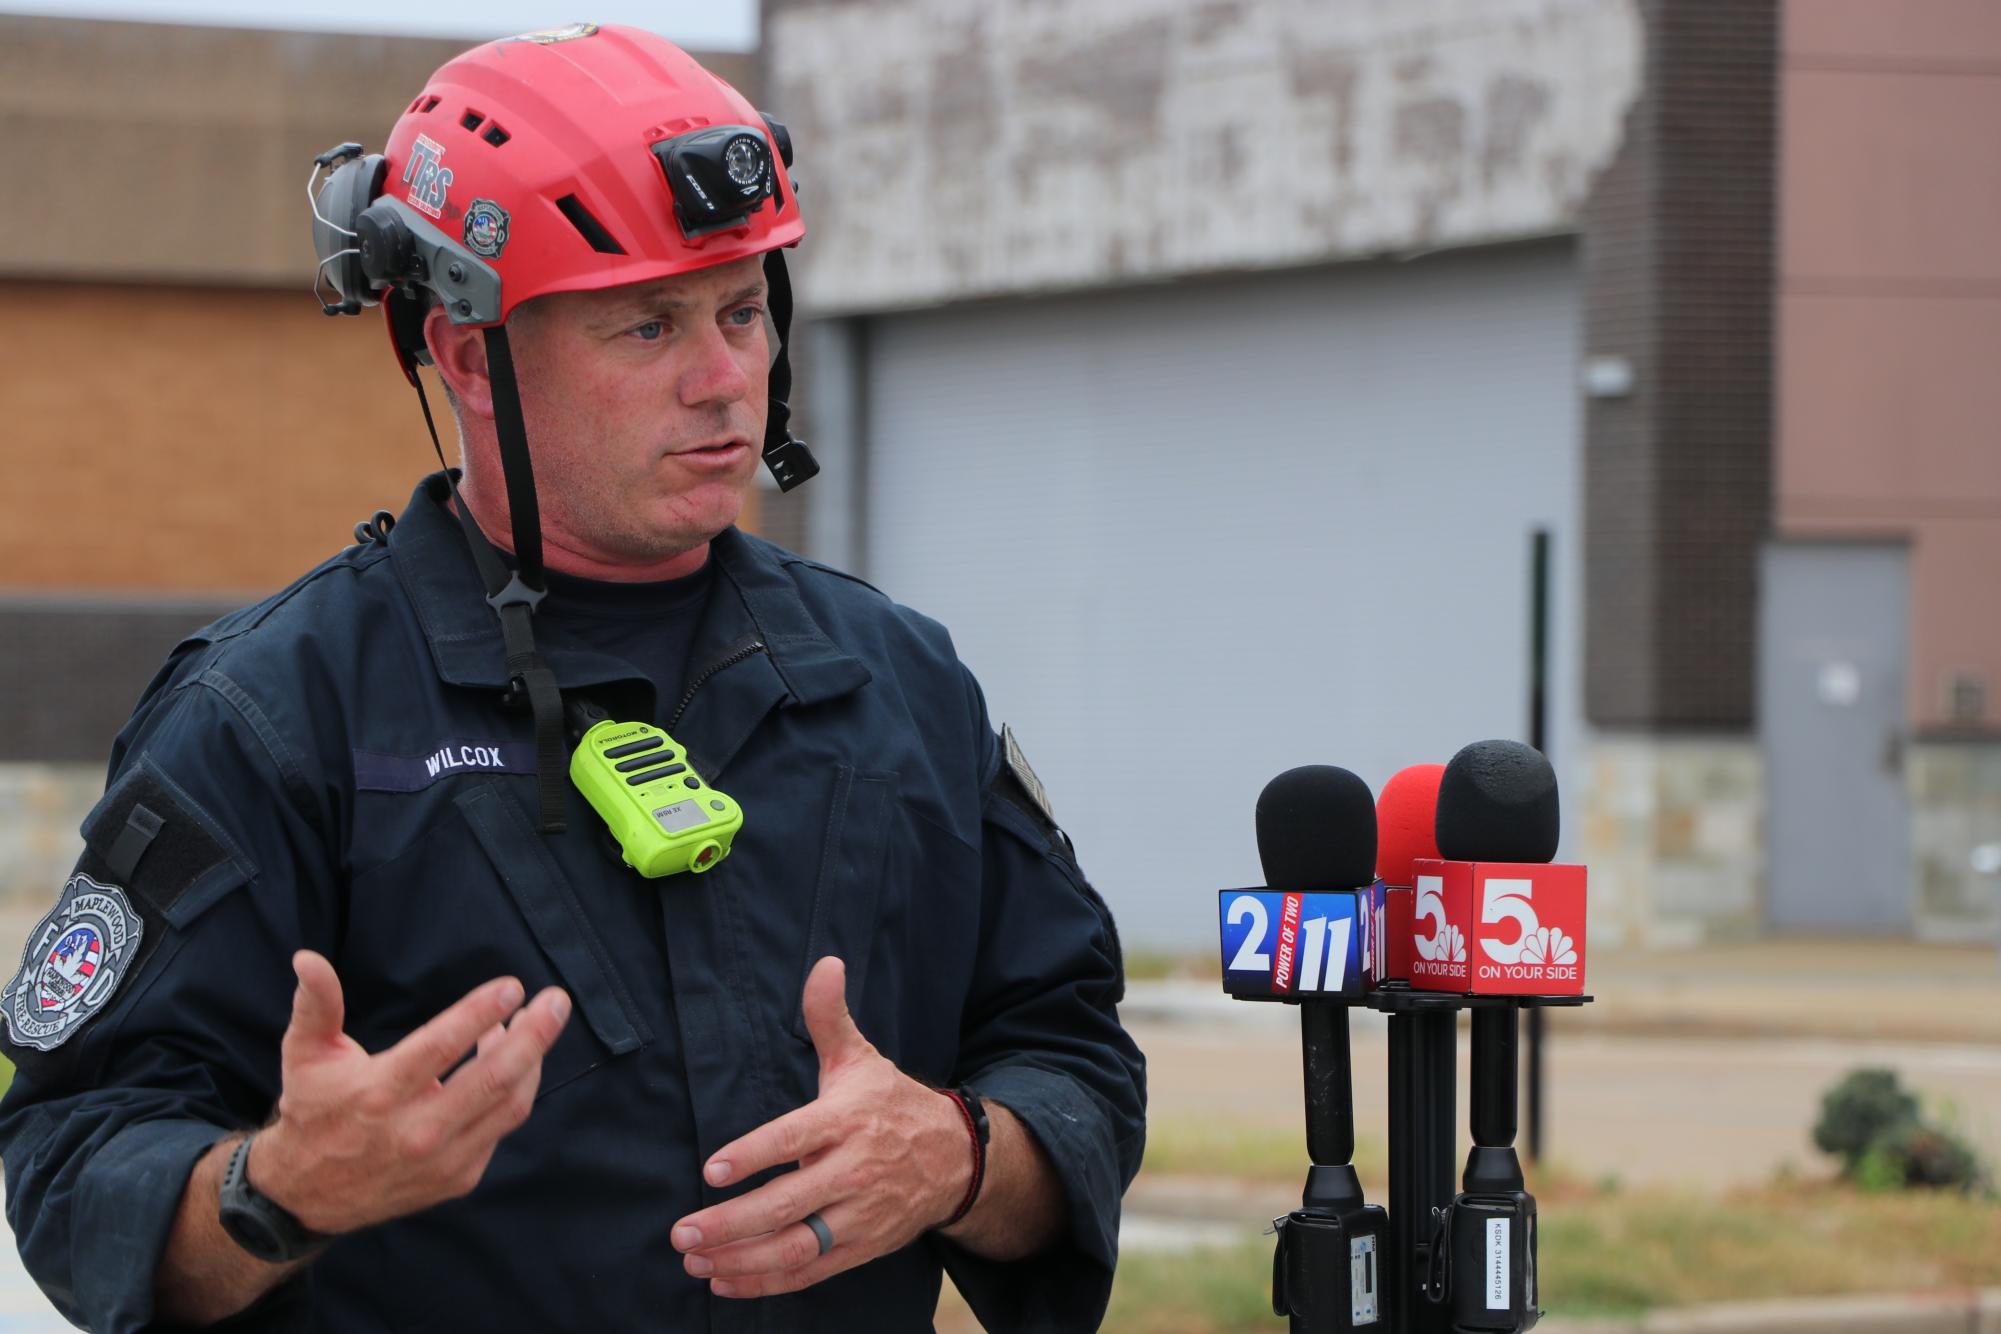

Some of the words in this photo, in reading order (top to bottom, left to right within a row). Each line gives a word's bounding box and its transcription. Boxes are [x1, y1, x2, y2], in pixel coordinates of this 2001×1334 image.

[598, 730, 638, 745] MOTOROLA
[425, 745, 505, 777] WILCOX
[74, 897, 125, 945] MAPLEWOOD
[1284, 895, 1300, 925] TWO
[1414, 875, 1447, 961] 5
[1479, 878, 1539, 965] 5
[1226, 895, 1271, 972] 2
[1282, 926, 1296, 944] OF
[1360, 894, 1371, 973] 2
[1275, 943, 1293, 989] POWER
[1298, 916, 1352, 992] 11
[1413, 962, 1426, 974] ON
[1426, 963, 1448, 977] YOUR
[1449, 964, 1467, 978] SIDE
[1478, 966, 1501, 979] ON
[1503, 966, 1544, 980] YOUR
[1546, 966, 1578, 980] SIDE
[1494, 1223, 1502, 1247] KSDK
